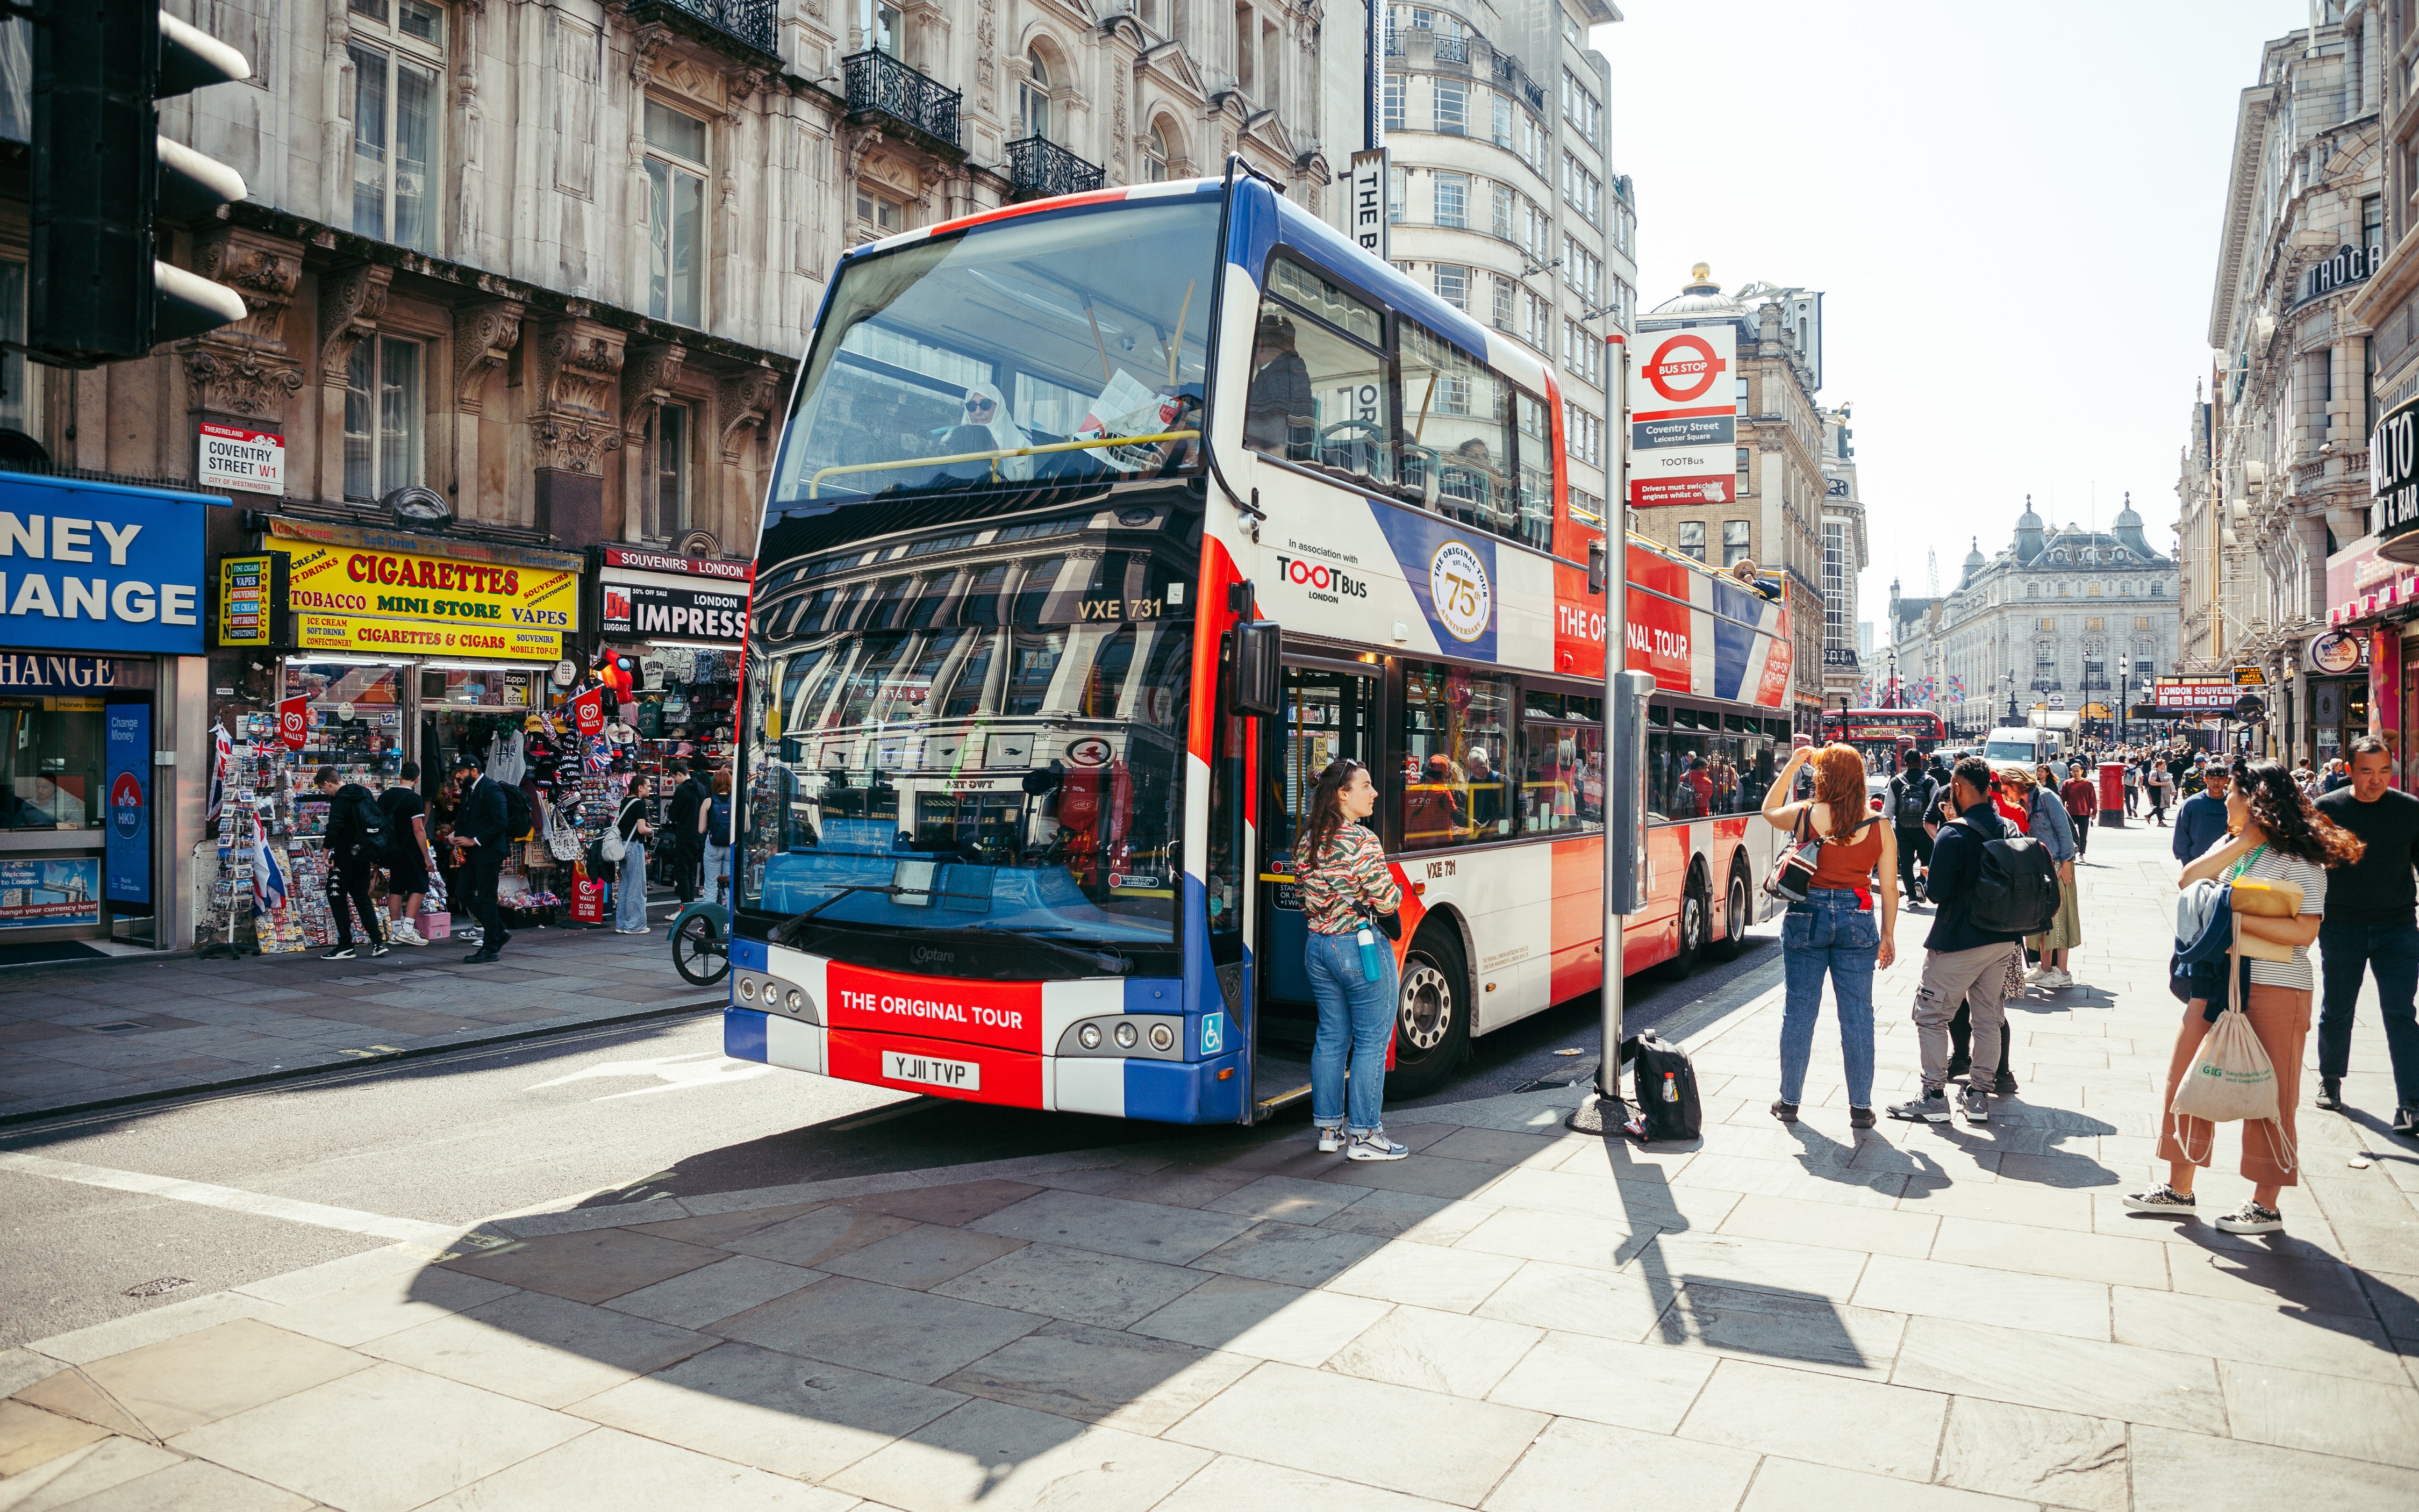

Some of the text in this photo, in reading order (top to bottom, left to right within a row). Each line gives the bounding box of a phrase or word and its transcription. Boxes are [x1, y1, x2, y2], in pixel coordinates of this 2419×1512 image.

[1359, 172, 1377, 226] THE
[2310, 244, 2383, 295] TROCA
[1659, 362, 1707, 374] BUS STOP
[204, 426, 243, 438] THEATRELAND
[1646, 422, 1719, 434] Coventry Street
[1654, 433, 1711, 443] Leicester Square
[209, 441, 271, 462] COVENTRY
[209, 457, 276, 478] STREET W1
[232, 480, 271, 491] WESTMINSTER
[1642, 493, 1668, 501] engines
[2388, 494, 2395, 527] &
[2398, 484, 2418, 522] BAR
[273, 521, 582, 570] Ice Cream Soft Drink Souvenirs Confectionery
[1289, 539, 1358, 564] In association with
[290, 548, 326, 570] CREAM
[621, 552, 743, 578] SOUVENIRS LONDON
[301, 557, 339, 581] DRINKS
[347, 554, 519, 596] CIGARETTES
[1434, 547, 1487, 598] THE ORIGINAL TOUR
[1462, 562, 1471, 573] 1951
[237, 577, 256, 586] VAPES
[524, 571, 569, 599] SOUVENIRS
[223, 563, 232, 639] OPEN
[232, 590, 259, 599] SOUVENIRS
[259, 561, 268, 639] TOBACCO
[527, 581, 572, 607] CONFECTIONERY
[694, 594, 738, 608] LONDON
[1309, 591, 1339, 604] LONDON
[232, 603, 258, 612] ICE CREAM
[290, 590, 501, 619] TOBACCO MINI STORE
[1078, 598, 1161, 619] VXE 731
[321, 618, 347, 627] CREAM
[511, 607, 567, 625] VAPES
[1441, 608, 1481, 635] ANNIVERSARY
[323, 628, 346, 636] DRINKS
[604, 622, 631, 632] LUGGAGE
[1559, 605, 1586, 638] THE
[1655, 628, 1687, 661] TOUR
[307, 637, 353, 647] CONFECTIONERY
[358, 628, 505, 648] CIGARETTES & CIGARS
[517, 634, 554, 643] SOUVENIRS
[511, 646, 559, 655] MOBILE TOP-UP
[1770, 659, 1788, 675] HOP-ON
[505, 676, 526, 684] zippo
[1764, 670, 1785, 685] HOP-OFF
[2159, 686, 2243, 695] LONDON SOUVENIRS
[111, 716, 138, 730] Change
[111, 730, 134, 743] Money
[284, 730, 303, 741] WALL'S
[1880, 728, 1895, 736] IMAGE
[118, 813, 135, 825] HKD
[1427, 860, 1456, 879] VXE 731
[917, 946, 955, 963] Optare
[841, 991, 1022, 1029] THE ORIGINAL TOUR
[932, 1062, 965, 1084] TVP
